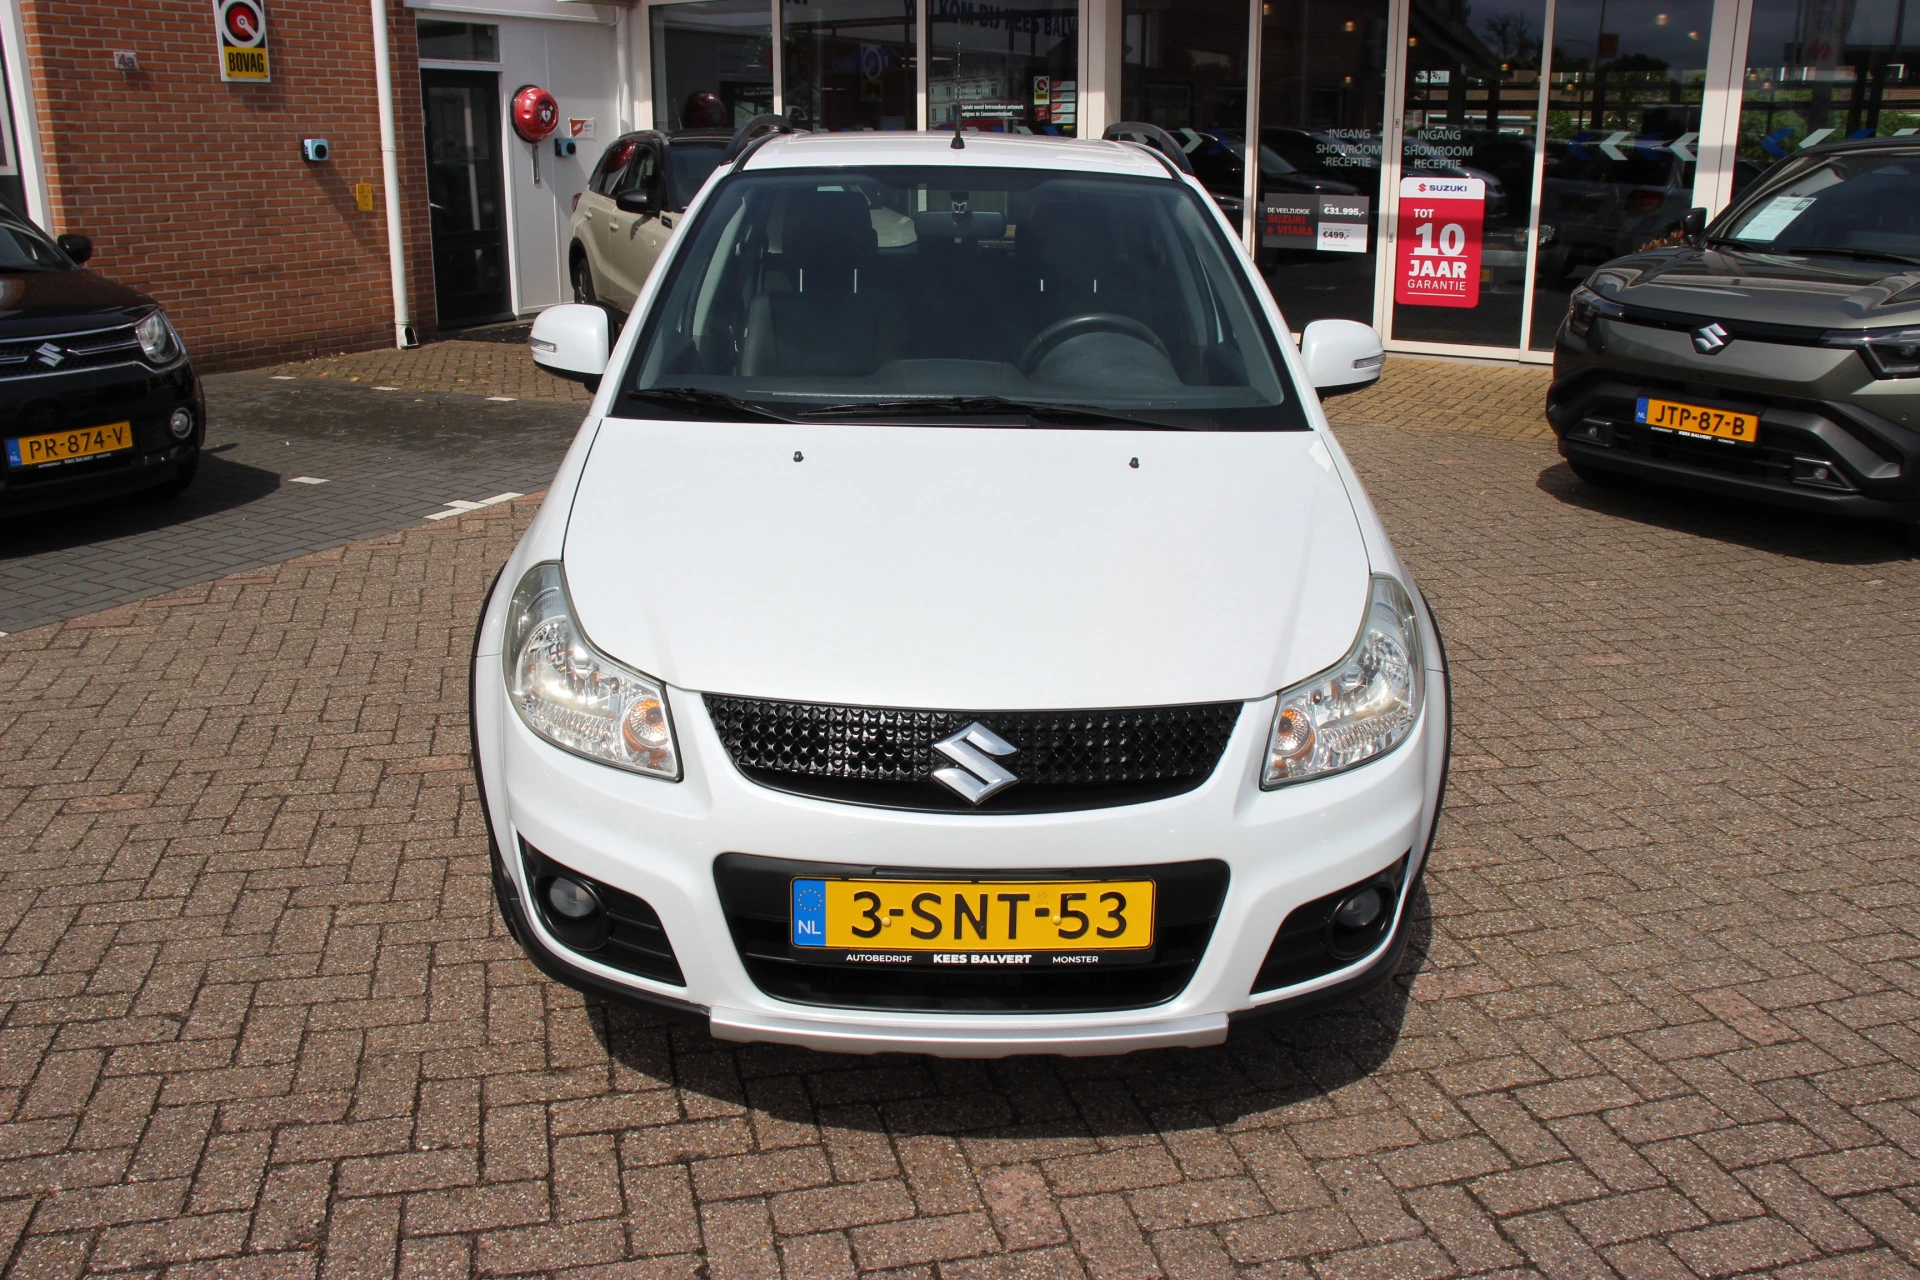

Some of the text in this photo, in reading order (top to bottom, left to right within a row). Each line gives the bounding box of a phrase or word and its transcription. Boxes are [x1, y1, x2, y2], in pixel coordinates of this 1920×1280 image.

[227, 52, 265, 73] BOVAG
[1328, 128, 1371, 139] INGANG
[1417, 130, 1461, 141] INGANG
[1315, 144, 1381, 155] SHOWROOM
[1403, 145, 1473, 157] SHOWROOM
[1414, 159, 1462, 170] RECEPTIE
[1429, 184, 1468, 192] SUZUKI
[1323, 206, 1365, 218] €31.995,-
[1413, 208, 1435, 219] TOT
[1267, 215, 1307, 225] SUZUKI
[1277, 226, 1314, 236] VITARA
[1322, 231, 1350, 240] €499,-
[1413, 222, 1466, 256] 10
[1408, 259, 1467, 279] JAAR
[1407, 279, 1467, 291] GARANTIE
[1637, 411, 1646, 419] NL
[1655, 404, 1746, 437] JTP-87-B
[28, 426, 124, 460] PR-874-V
[851, 891, 1127, 940] 3-SNT-53
[797, 919, 822, 935] NL
[846, 953, 1100, 965] AUTOBEDRIJF KEES BALVERT MONSTER
